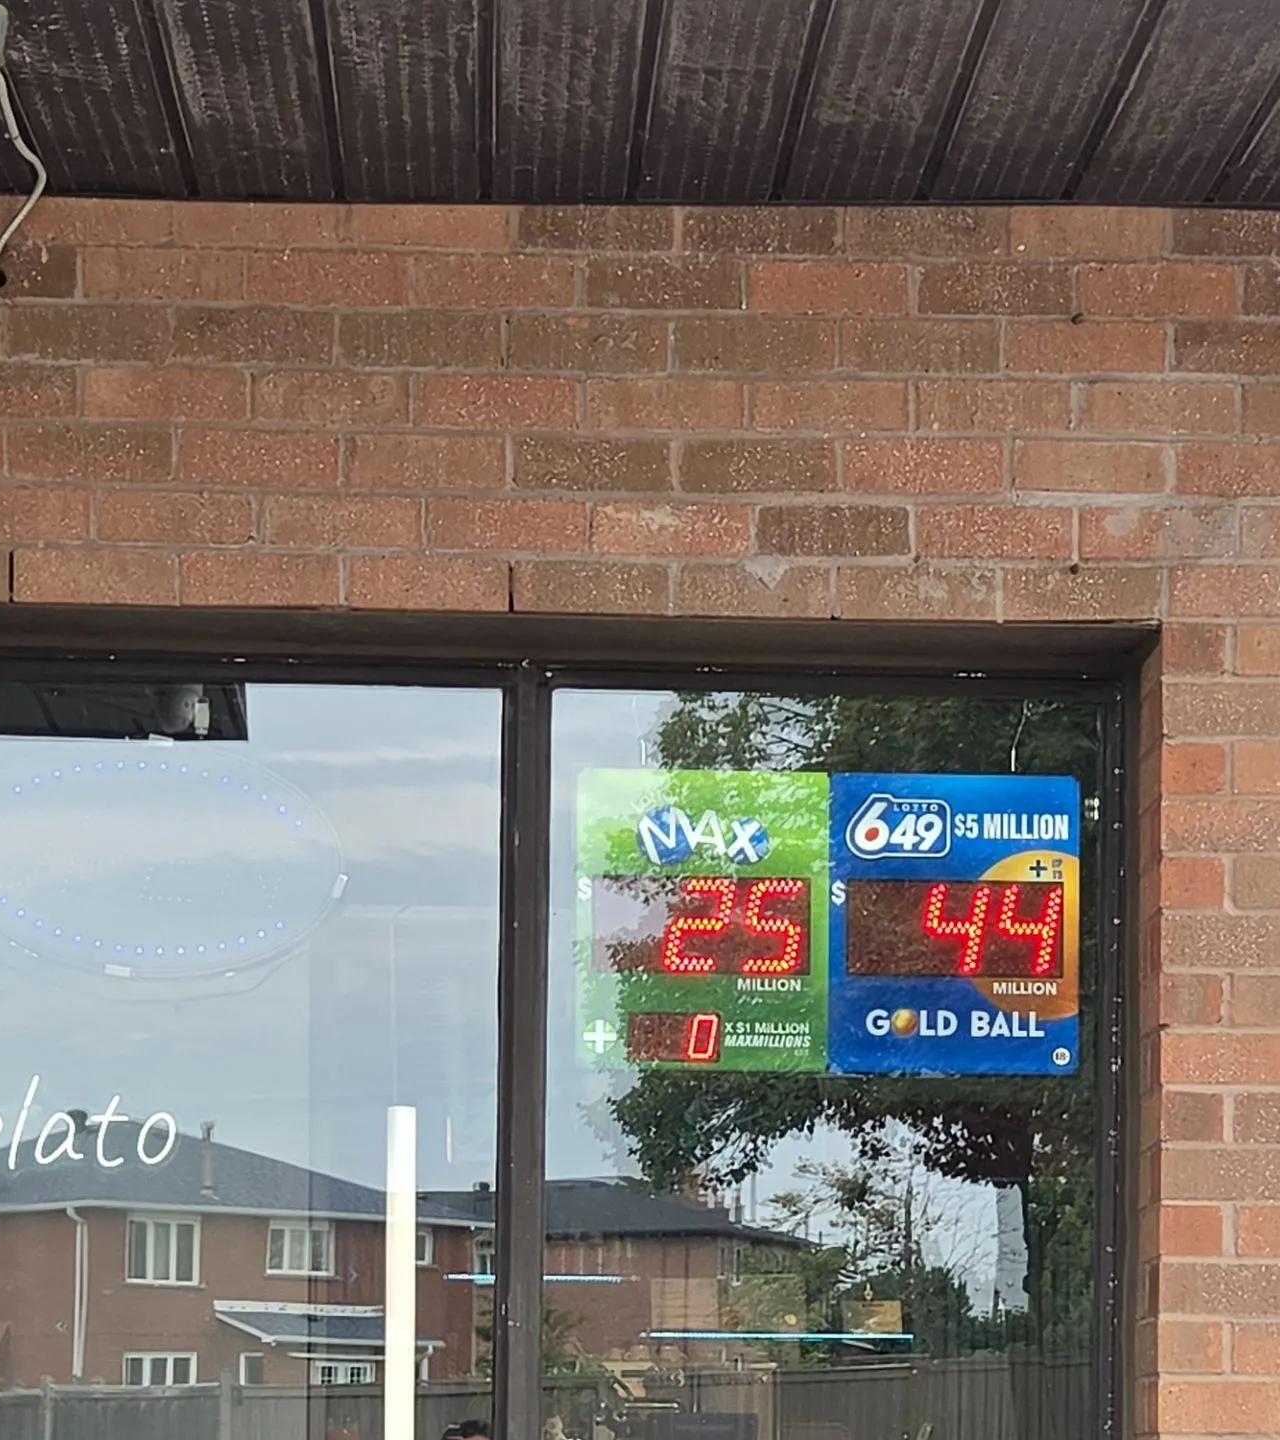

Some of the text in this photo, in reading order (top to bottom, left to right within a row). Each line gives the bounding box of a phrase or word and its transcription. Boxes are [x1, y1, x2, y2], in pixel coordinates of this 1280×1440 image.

[893, 803, 939, 812] LOTTO
[638, 806, 761, 865] MAX
[853, 801, 943, 852] 649
[953, 813, 1069, 840] $5 MILLION
[663, 878, 804, 973] 25
[830, 880, 1063, 975] $ 44
[737, 978, 802, 992] MILLION
[992, 981, 1057, 996] MILLION
[687, 1013, 719, 1060] 0
[736, 1021, 750, 1034] $1
[754, 1021, 810, 1034] MILLION
[970, 1010, 1046, 1038] BALL
[723, 1034, 812, 1048] MAXMILLIONS
